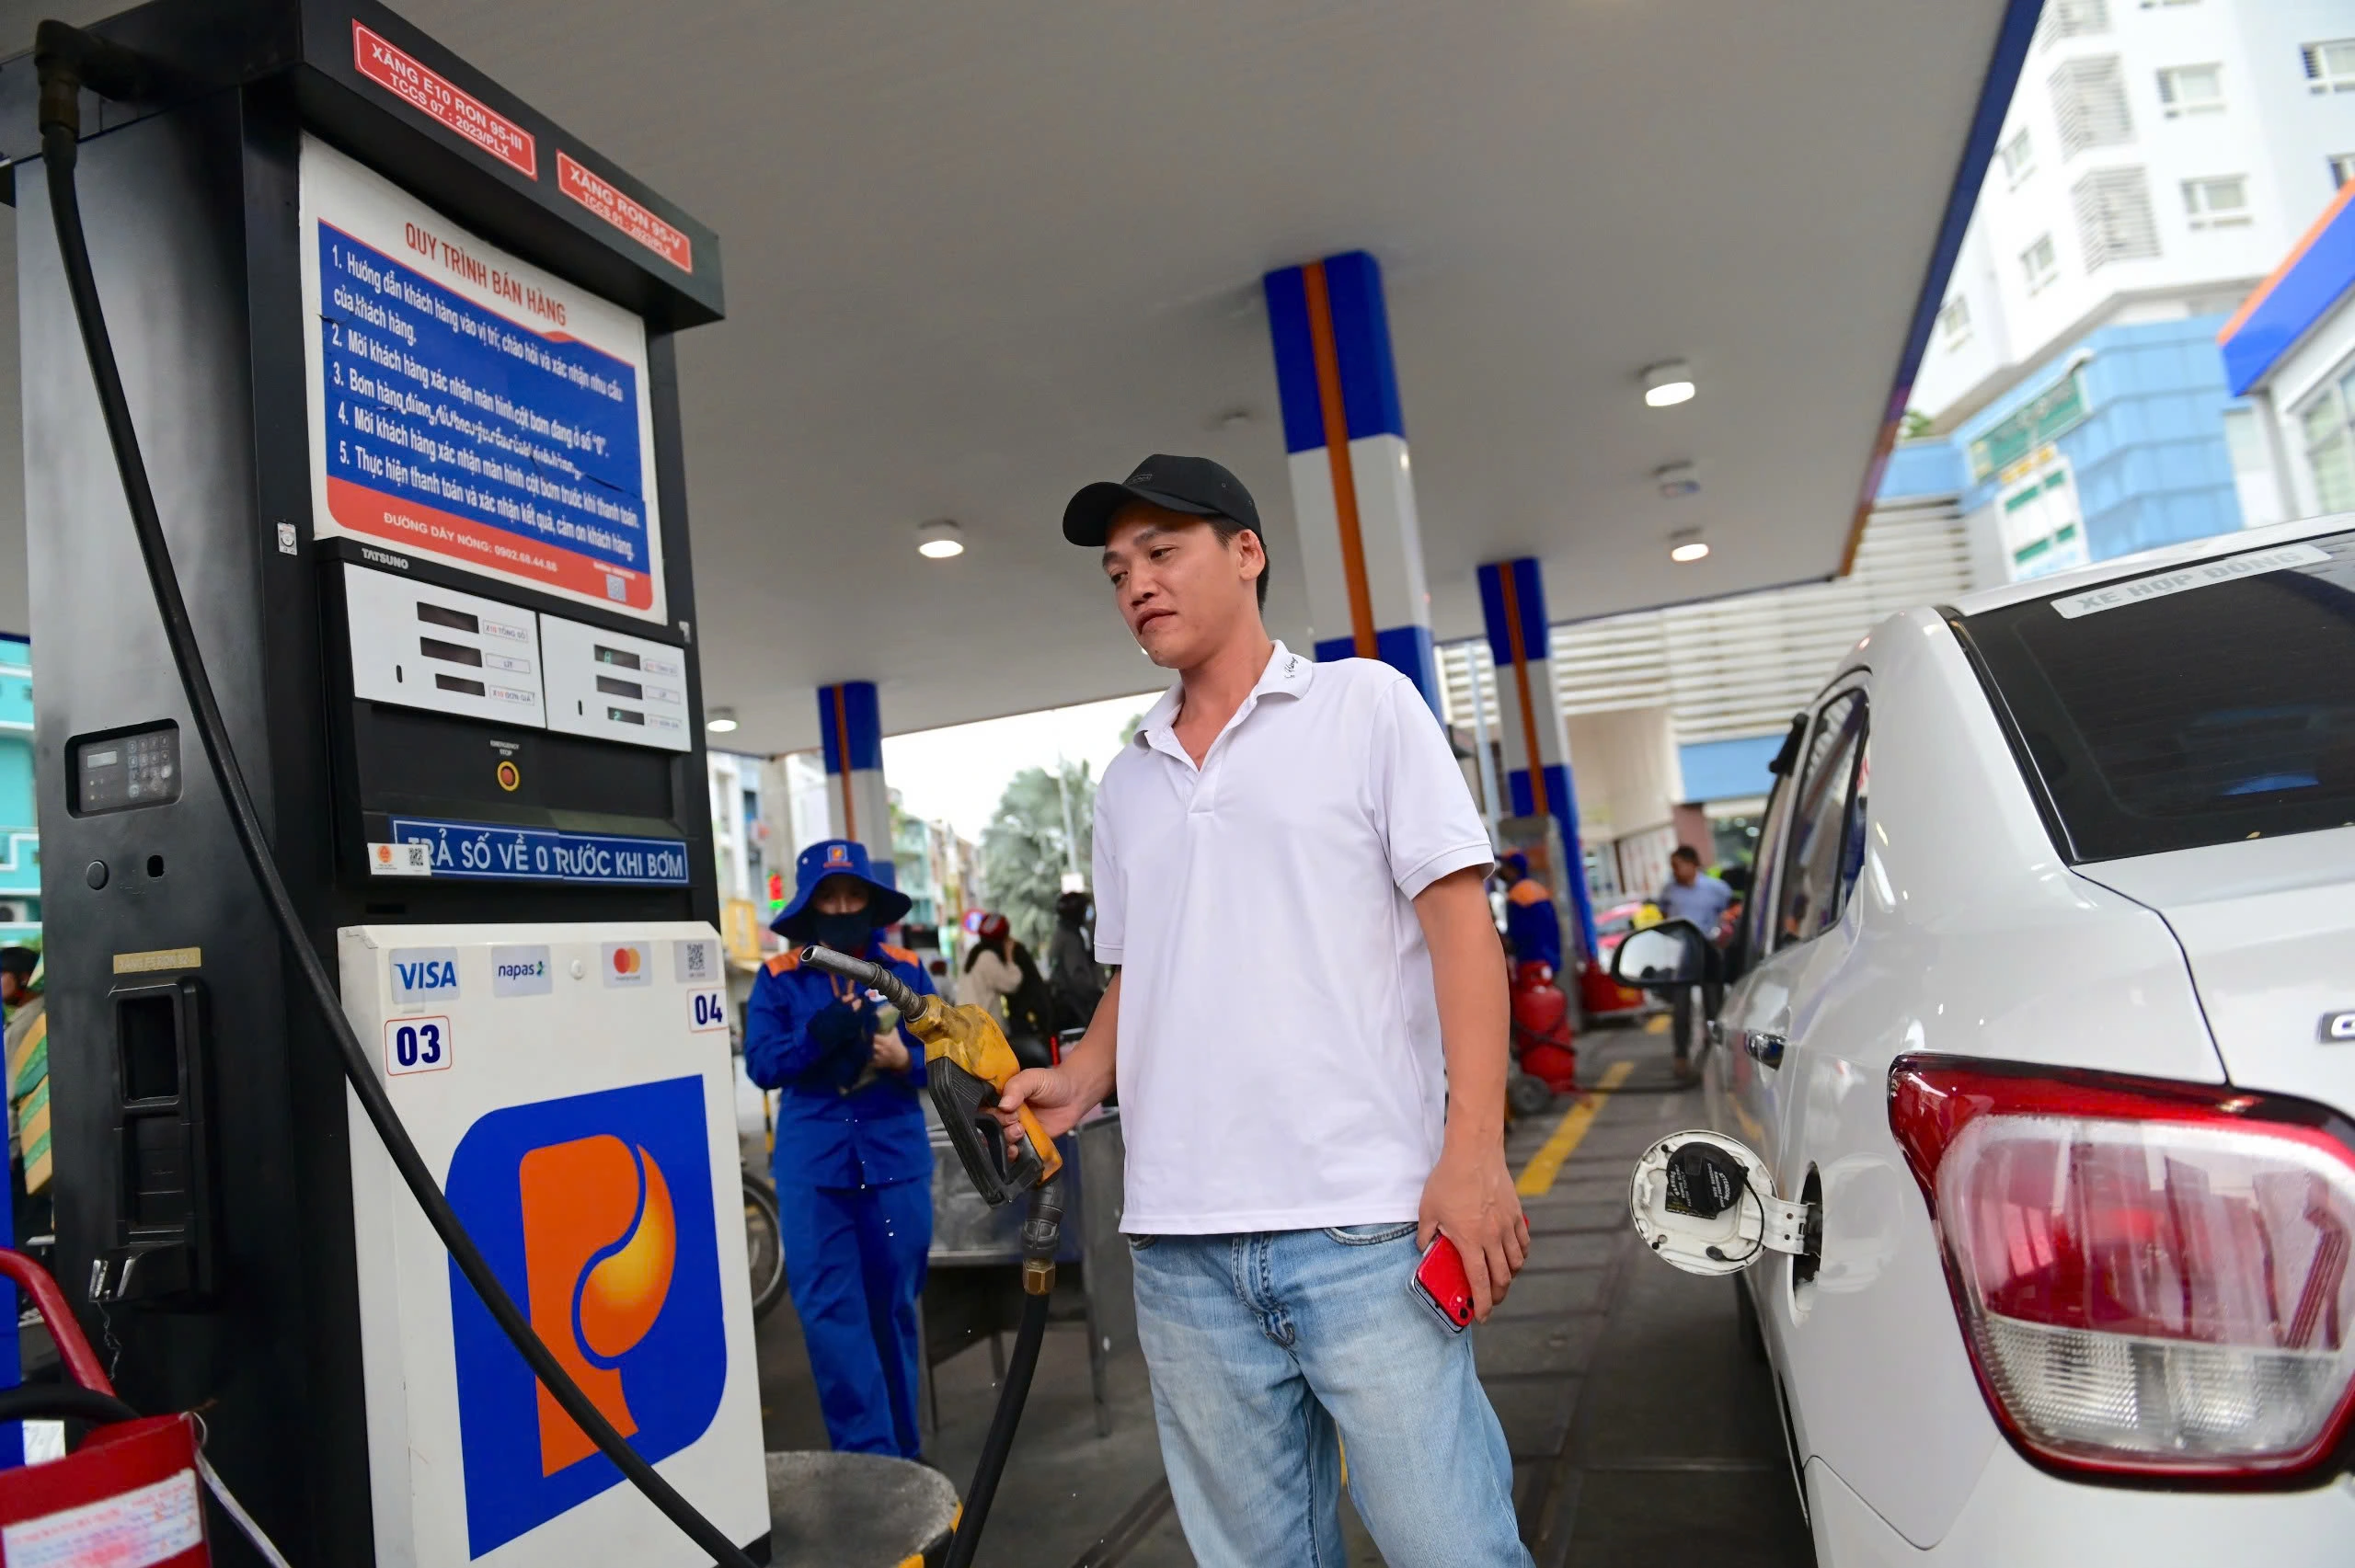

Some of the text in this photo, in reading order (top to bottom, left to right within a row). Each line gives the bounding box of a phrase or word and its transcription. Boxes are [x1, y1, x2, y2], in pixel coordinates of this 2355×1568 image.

[372, 42, 523, 151] XĂNG E10 RON 95-III
[390, 72, 427, 106] TCCS
[430, 100, 445, 116] 07
[455, 116, 510, 156] 2023/PLX
[617, 197, 649, 229] RON
[332, 245, 343, 269] 1.
[347, 251, 381, 294] Hướng
[383, 269, 402, 300] dẫn
[404, 281, 434, 315] khách
[434, 297, 459, 334] hàng
[459, 312, 477, 337] vào
[405, 222, 567, 326] QUY TRÌNH BÁN HÀNG
[334, 284, 417, 348] của khách hàng.
[332, 323, 343, 348] 2.
[348, 328, 368, 358] Mời
[370, 338, 401, 372] khách
[403, 353, 429, 389] hàng
[431, 368, 448, 393] xác
[449, 375, 473, 405] nhận
[474, 388, 494, 413] màn
[494, 393, 515, 420] hình
[333, 361, 344, 386] 3.
[350, 367, 374, 398] Bơm
[376, 378, 407, 416] hàng
[338, 401, 349, 426] 4.
[354, 406, 373, 435] Mời
[376, 415, 408, 448] khách
[410, 428, 436, 463] hàng
[437, 441, 455, 464] xác
[457, 447, 481, 476] nhận
[482, 458, 503, 481] màn
[503, 462, 525, 489] hình
[339, 441, 350, 465] 5.
[354, 445, 384, 479] Thực
[385, 456, 408, 486] hiện
[410, 465, 441, 495] thanh
[442, 476, 464, 503] toán
[465, 485, 477, 507] và
[478, 490, 496, 513] xác
[497, 496, 521, 523] nhận
[384, 511, 428, 534] ĐƯỜNG
[431, 525, 455, 543] DÂY
[362, 547, 409, 570] TATSUNO
[2076, 588, 2121, 610] XE
[461, 831, 491, 870] SỐ
[497, 832, 529, 871] VỀ
[535, 845, 548, 872] 0
[615, 851, 644, 876] KHI
[647, 850, 684, 877] BƠM
[394, 960, 457, 990] VISA
[497, 962, 535, 980] napas
[695, 994, 723, 1025] 04
[396, 1024, 441, 1067] 03
[1670, 1171, 1680, 1196] WARNING
